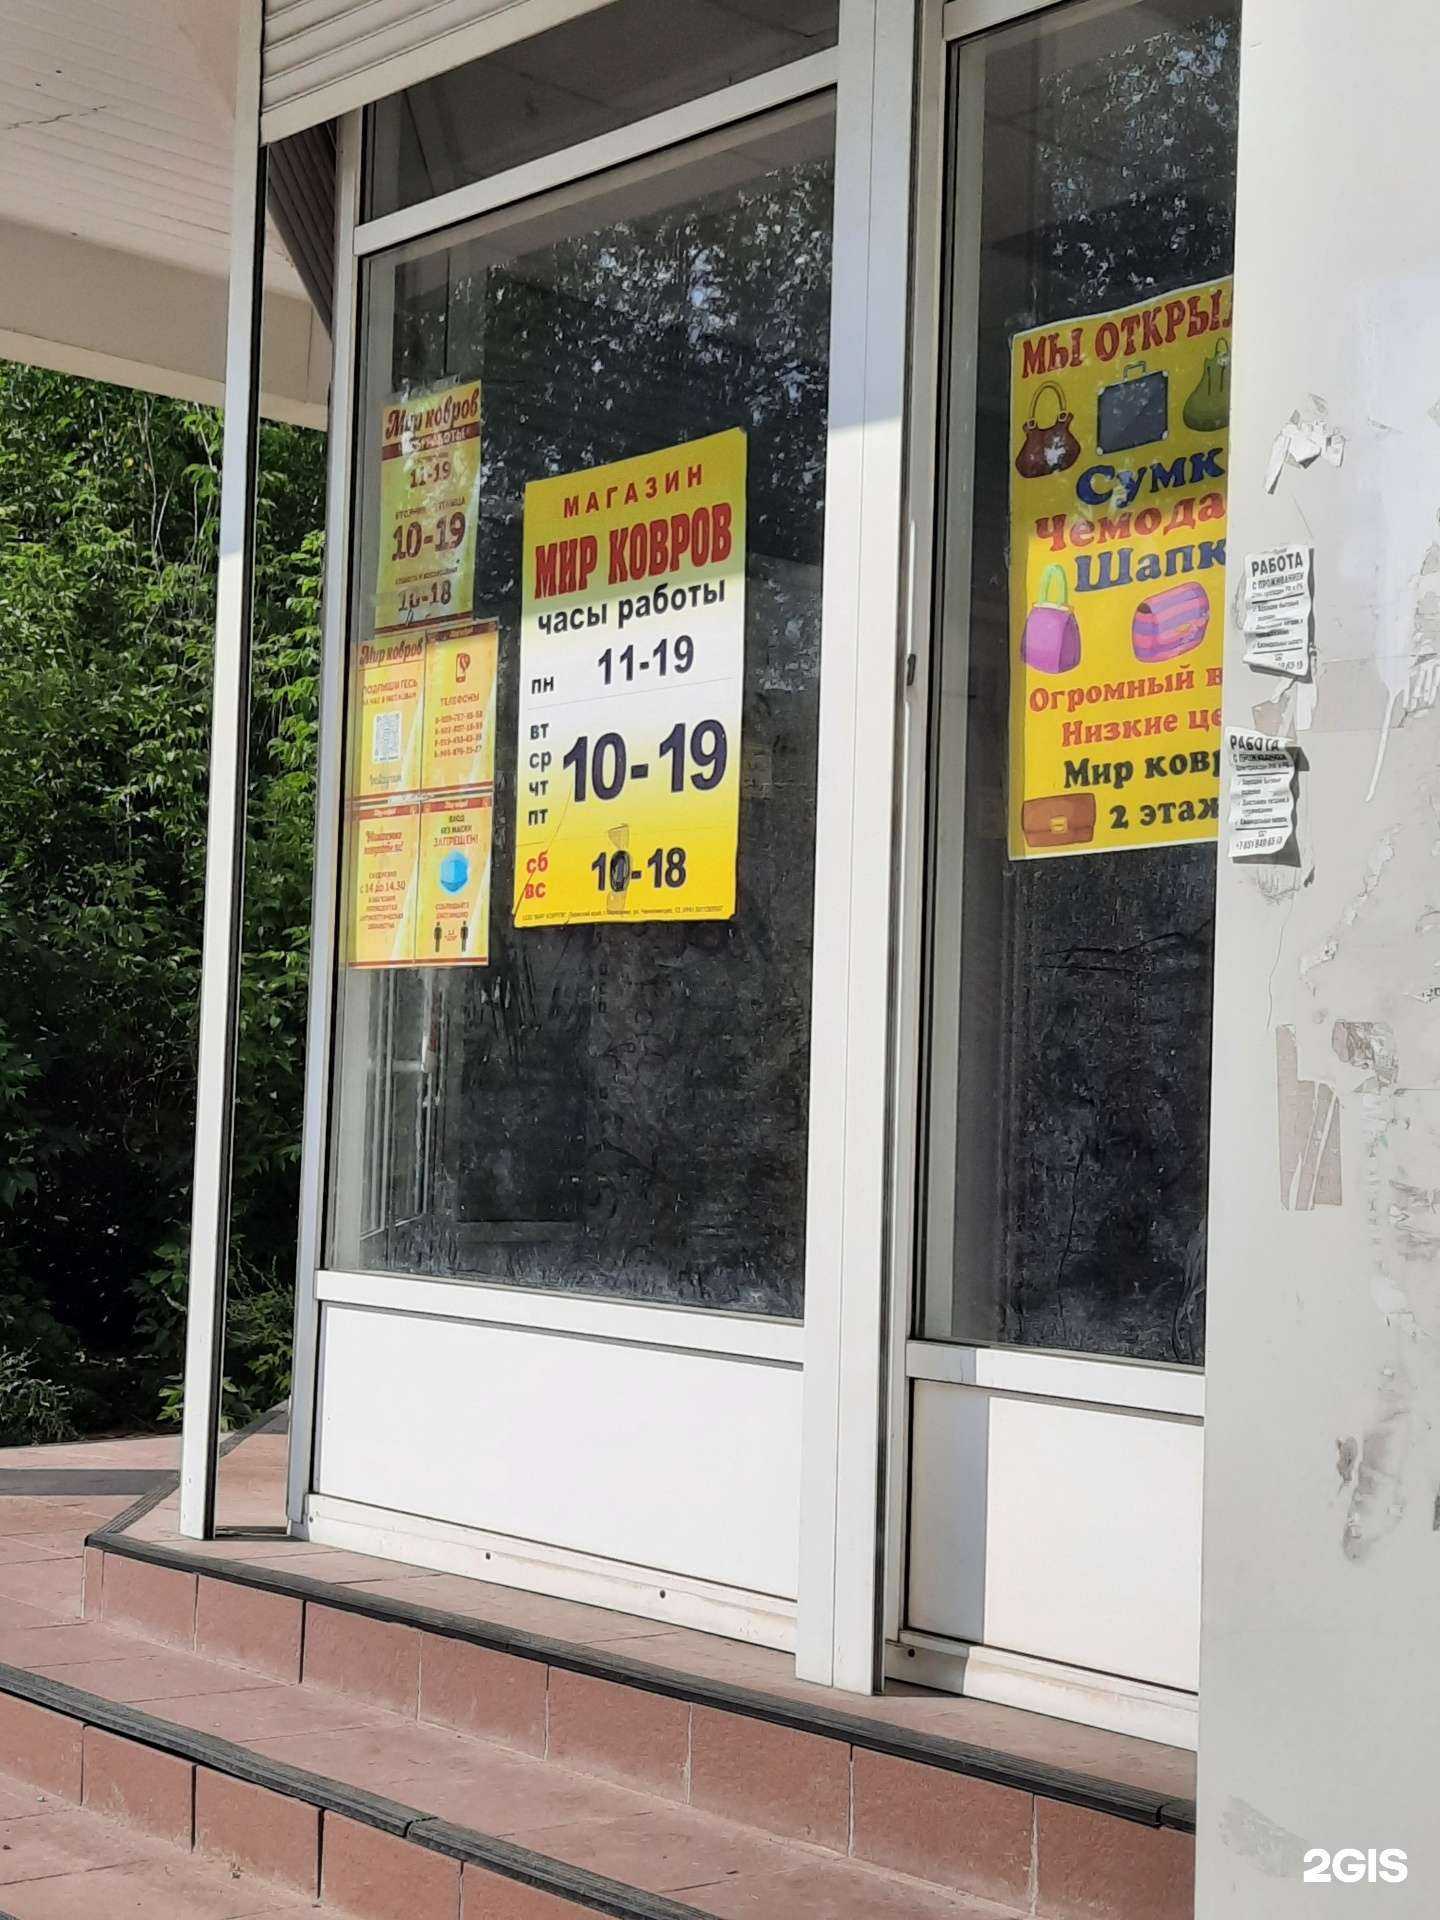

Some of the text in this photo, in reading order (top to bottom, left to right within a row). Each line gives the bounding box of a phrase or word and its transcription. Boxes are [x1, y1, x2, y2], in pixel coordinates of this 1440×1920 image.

[1022, 327, 1084, 379] МЫ
[425, 387, 480, 429] ковров
[563, 463, 703, 518] МАГАЗИН
[392, 511, 466, 561] 10-19
[1035, 491, 1226, 552] Чемода
[534, 502, 732, 600] МИР КОВРОВ
[1074, 537, 1227, 593] Шапк
[1251, 551, 1304, 578] РАБОТА
[538, 579, 726, 636] часы работы
[598, 634, 694, 685] 11-19
[531, 676, 555, 694] пн
[1029, 664, 1195, 713] Огромный
[530, 722, 549, 740] вт
[1062, 712, 1179, 748] Низкие
[1230, 735, 1280, 752] РАБОТА
[529, 751, 552, 774] ср
[562, 719, 728, 802] 10-19
[1063, 757, 1134, 789] Мир
[529, 780, 549, 797] чт
[528, 808, 549, 826] пт
[1110, 804, 1129, 830] 2
[526, 850, 549, 874] сб
[592, 847, 687, 892] 10-18
[525, 882, 546, 899] вс
